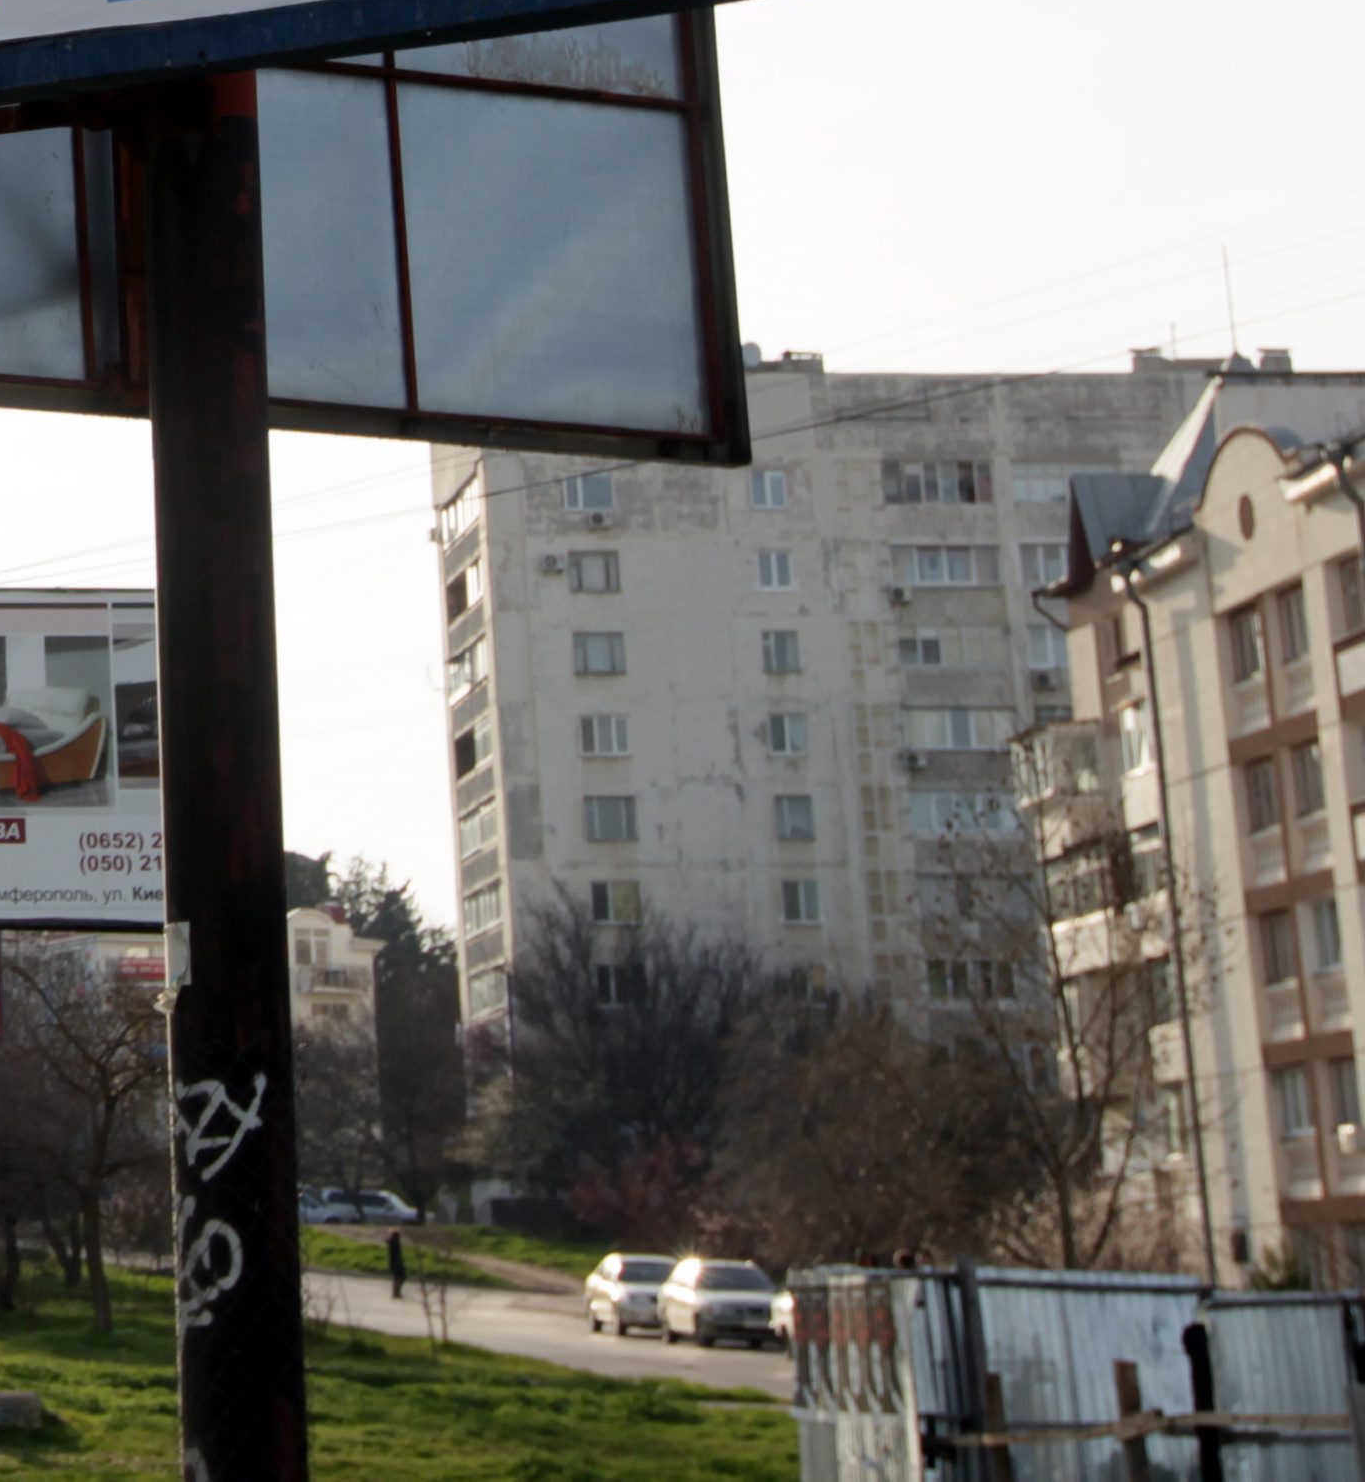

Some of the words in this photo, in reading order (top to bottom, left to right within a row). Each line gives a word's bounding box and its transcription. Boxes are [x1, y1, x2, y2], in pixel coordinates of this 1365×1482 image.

[78, 832, 144, 852] (0652)
[79, 855, 132, 875] (050)
[103, 889, 125, 905] ул.
